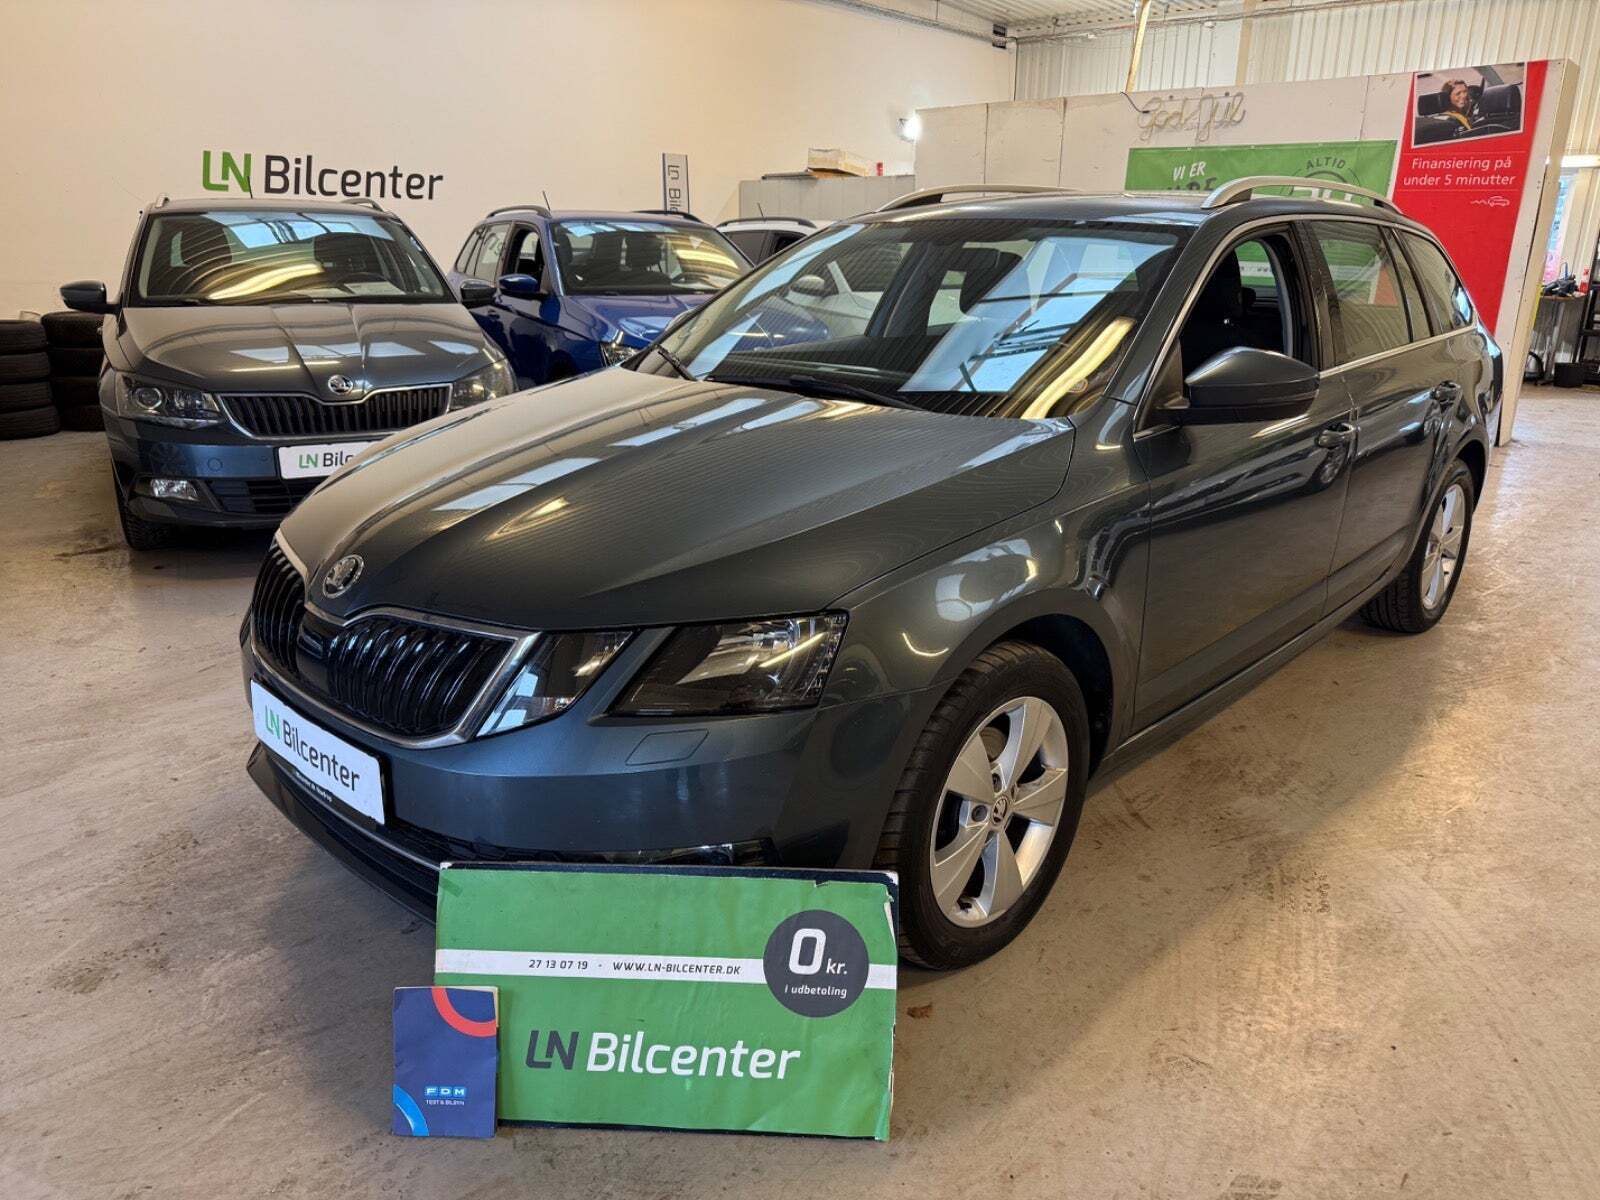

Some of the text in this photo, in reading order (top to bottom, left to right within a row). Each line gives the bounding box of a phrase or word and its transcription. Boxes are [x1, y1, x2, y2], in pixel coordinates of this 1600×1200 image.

[1172, 161, 1207, 181] VI ER
[1306, 156, 1346, 170] ALTID
[1411, 155, 1512, 172] Finansiering på
[202, 150, 443, 200] LN Bilcenter
[1403, 174, 1516, 186] under 5 minutter
[298, 453, 319, 469] LN
[265, 704, 281, 741] LN
[282, 719, 361, 792] Bilcenter
[788, 928, 848, 976] 0 kr.
[528, 959, 741, 976] 27 13 07 19 WWW.LN-BILCENTER.DK
[791, 984, 848, 999] udbetaling
[525, 1030, 801, 1080] LN Bilcenter
